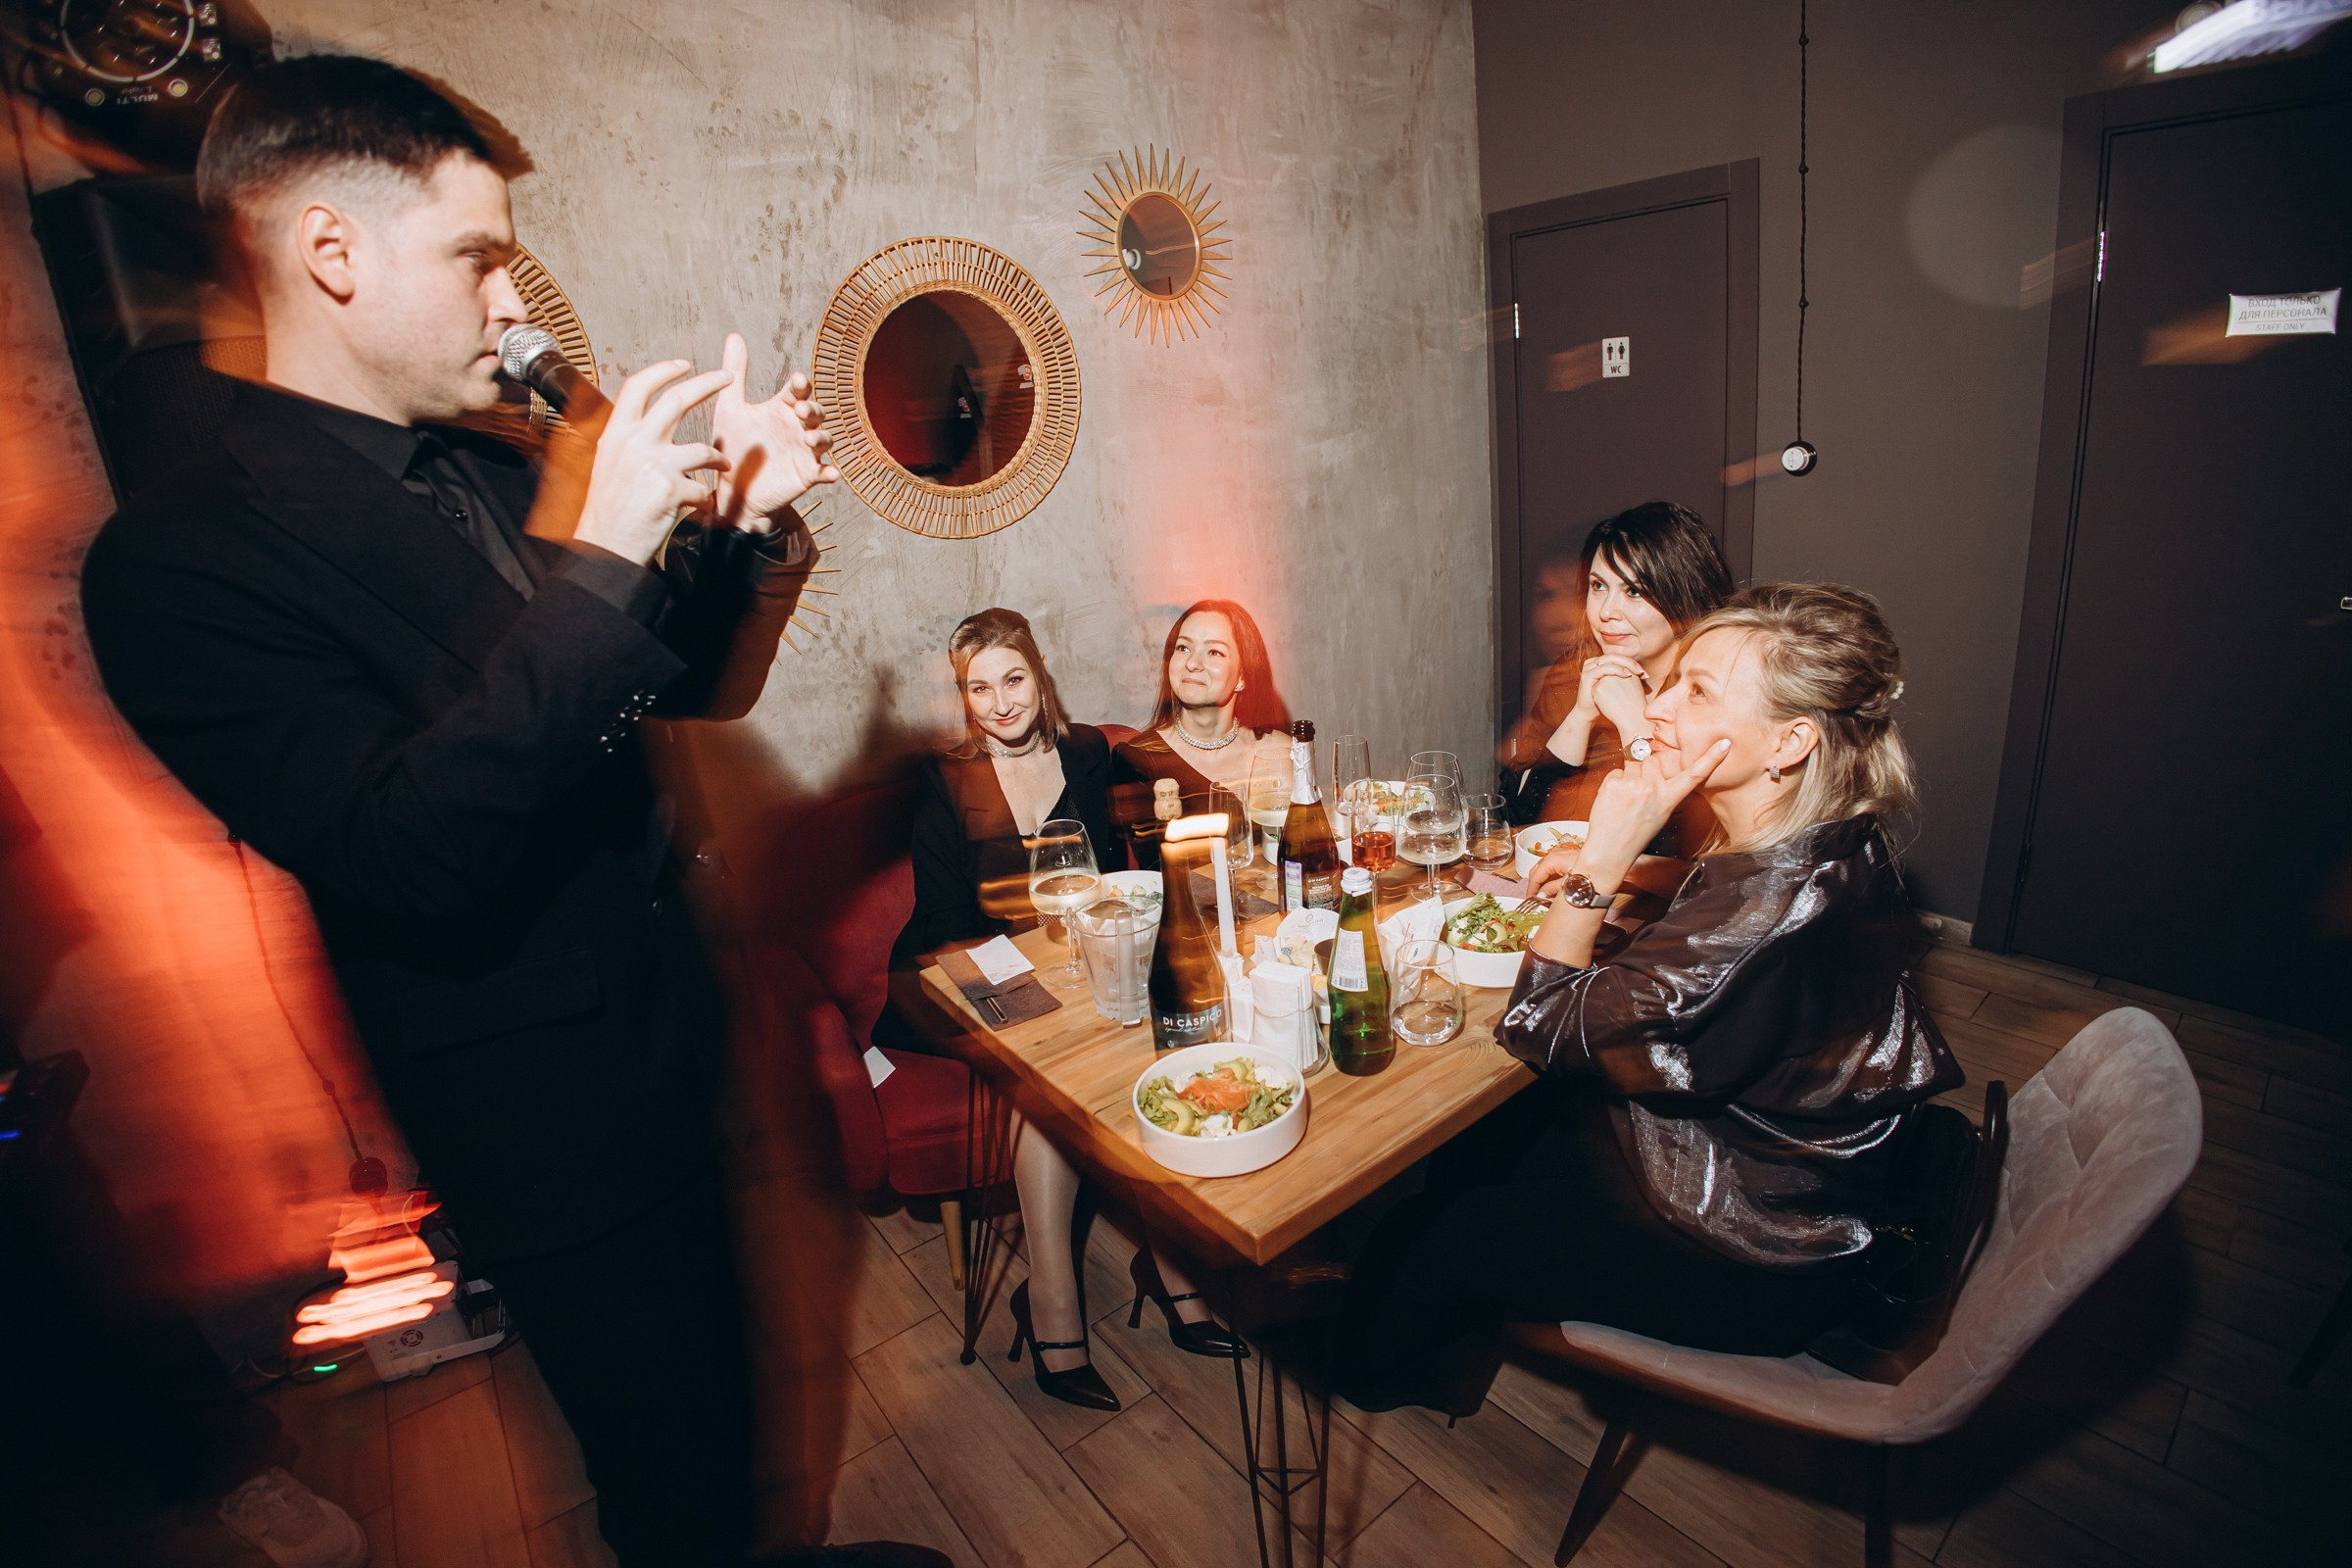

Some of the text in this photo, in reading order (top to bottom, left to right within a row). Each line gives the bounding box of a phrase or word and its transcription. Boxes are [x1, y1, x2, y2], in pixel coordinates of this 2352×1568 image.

[117, 93, 159, 105] MULTI
[2247, 295, 2322, 309] ВХОД ТОЛЬКО
[2238, 307, 2328, 321] ДЛЯ ПЕРСОНАЛА
[2256, 322, 2306, 332] STAFF ONLY
[1610, 365, 1622, 374] WC
[1162, 1008, 1222, 1028] DI CASPICO
